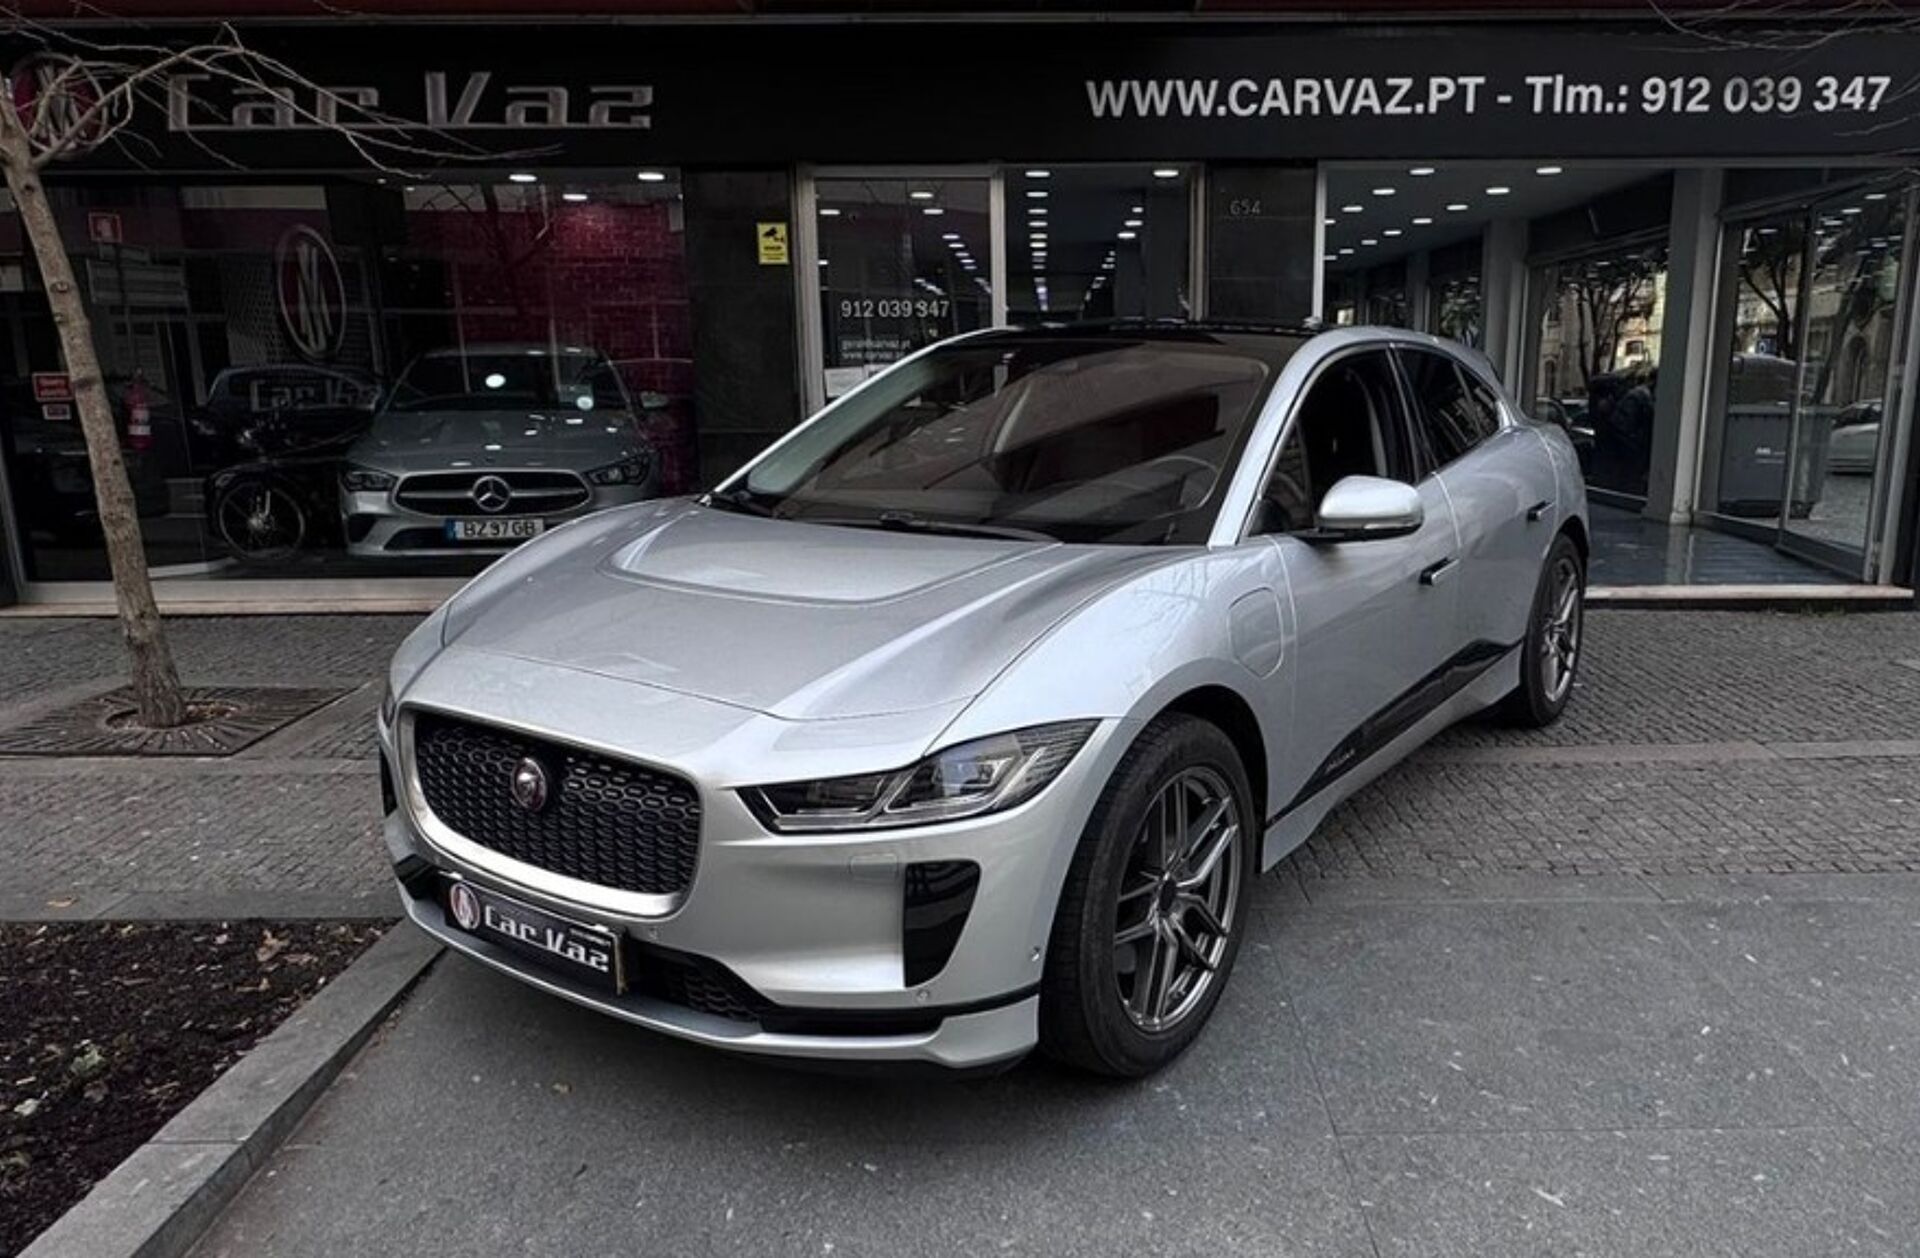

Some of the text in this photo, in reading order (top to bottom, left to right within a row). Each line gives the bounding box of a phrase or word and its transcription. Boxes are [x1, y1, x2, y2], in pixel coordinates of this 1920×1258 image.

[168, 71, 654, 131] Car Vaz
[1086, 76, 1486, 117] WWW.CARVAZ.PT
[1525, 74, 1628, 113] Tlm.:
[1641, 77, 1711, 113] 912
[1723, 77, 1802, 113] 039
[1813, 76, 1891, 112] 347
[841, 300, 950, 318] 912 039 347
[484, 904, 538, 942] Car
[546, 928, 610, 973] Vaz
